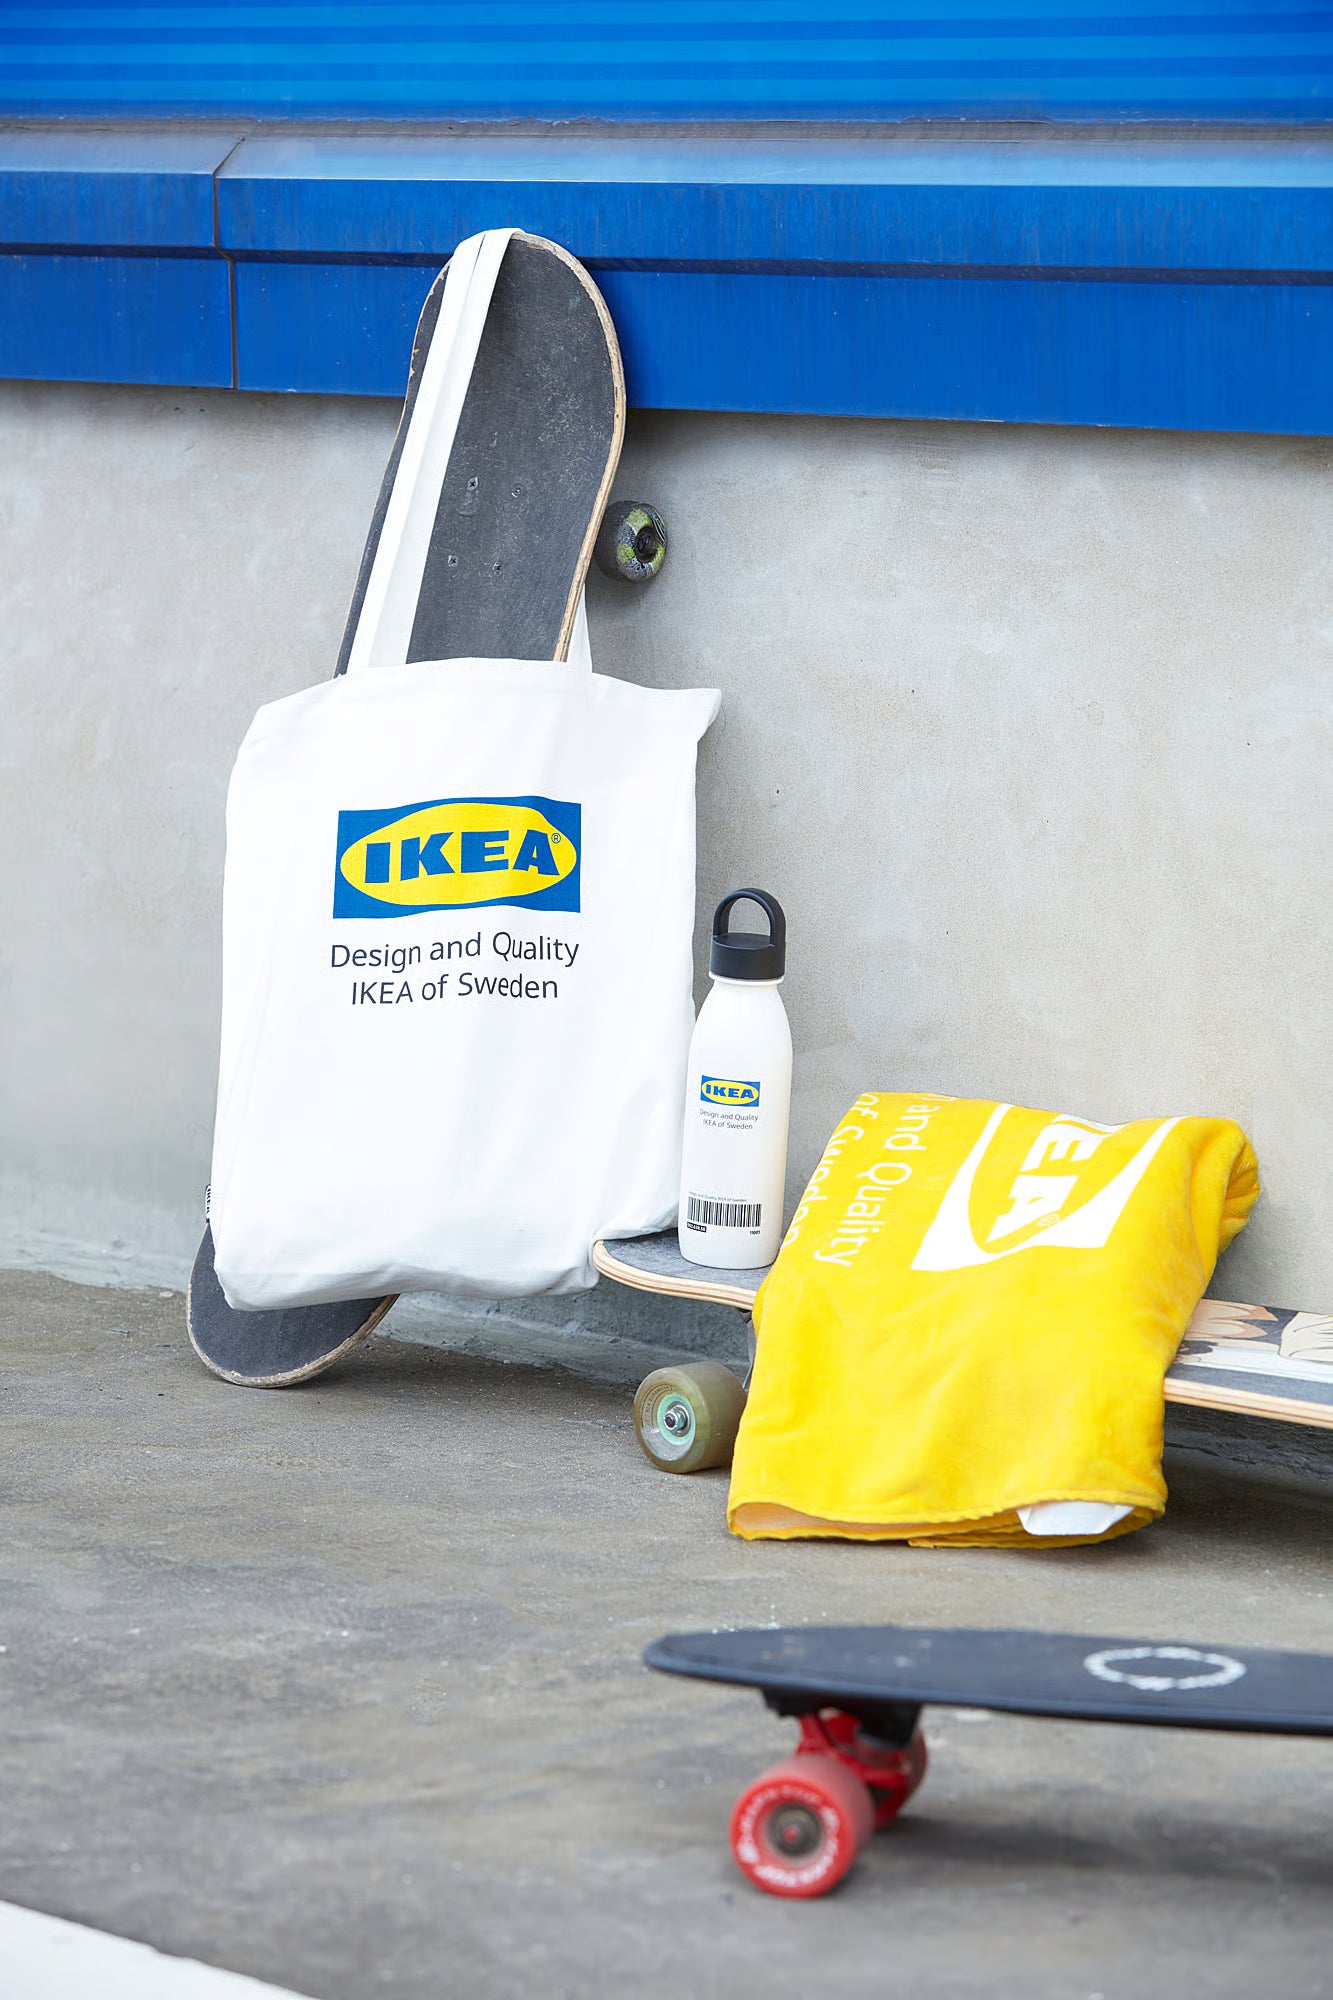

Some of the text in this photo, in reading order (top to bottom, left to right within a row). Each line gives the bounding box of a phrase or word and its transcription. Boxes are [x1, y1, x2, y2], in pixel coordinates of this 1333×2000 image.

[330, 931, 580, 974] Design and Quality
[351, 972, 559, 1006] IKEA of Sweden
[705, 1083, 755, 1100] IKEA
[699, 1108, 759, 1123] Design and Quality
[726, 1121, 753, 1130] Sweden
[883, 1103, 942, 1151] and
[813, 1161, 913, 1268] Quality
